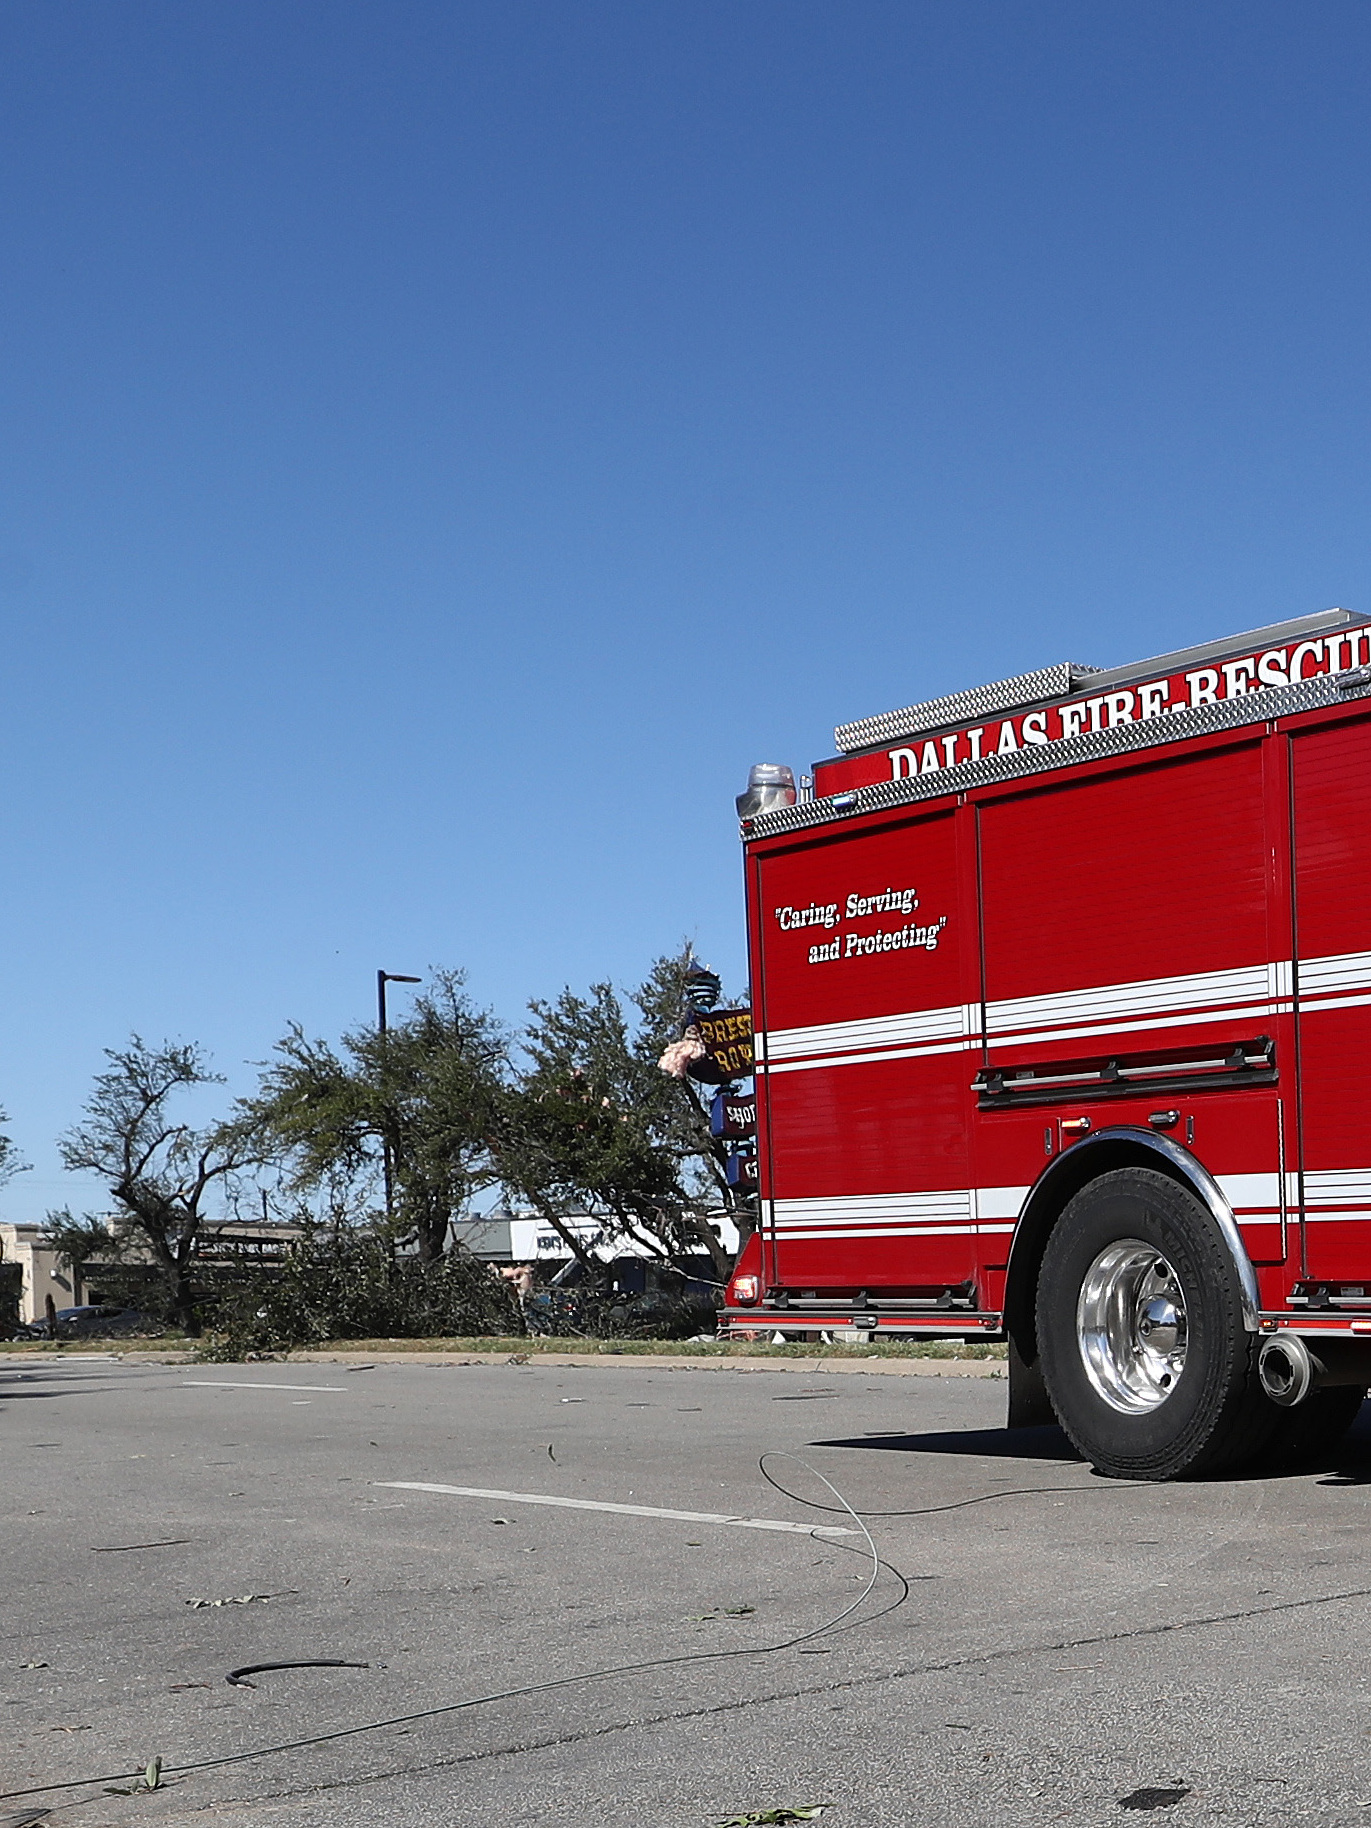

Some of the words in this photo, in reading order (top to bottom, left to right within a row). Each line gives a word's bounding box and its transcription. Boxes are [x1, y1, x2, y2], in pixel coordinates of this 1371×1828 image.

[889, 711, 1049, 782] DALLAS
[775, 903, 840, 930] "Caring,
[846, 888, 919, 918] Serving,
[809, 936, 840, 964] and
[845, 916, 947, 957] Protecting"
